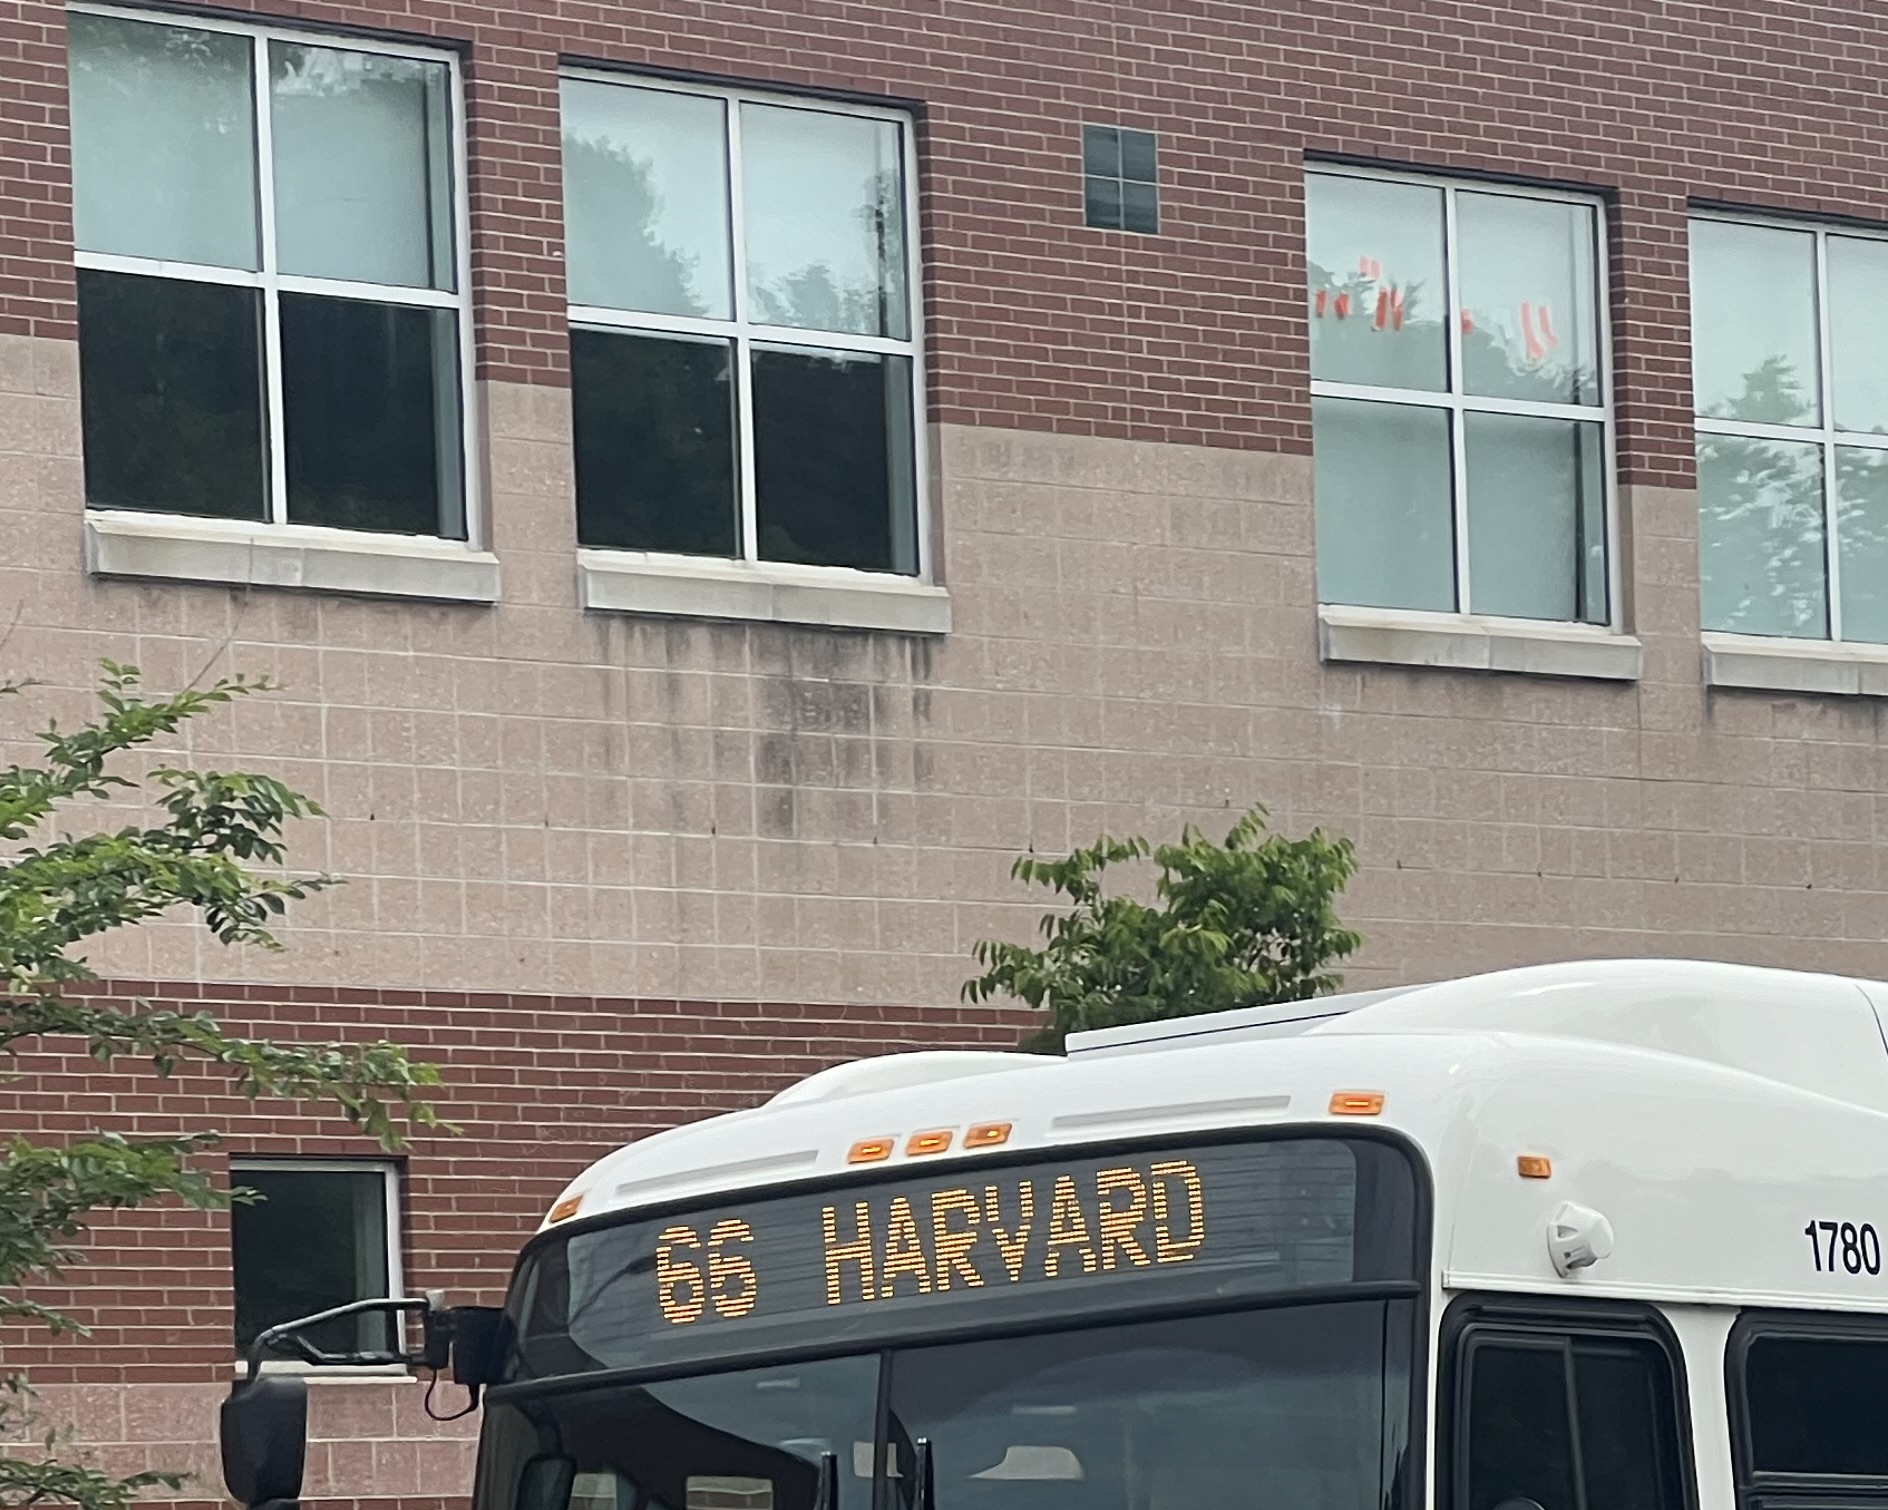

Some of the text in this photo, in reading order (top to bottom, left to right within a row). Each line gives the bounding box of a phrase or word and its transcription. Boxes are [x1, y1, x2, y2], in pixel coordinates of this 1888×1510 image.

[655, 1159, 1206, 1325] 66 HARVARD
[1804, 1220, 1882, 1276] 1780
